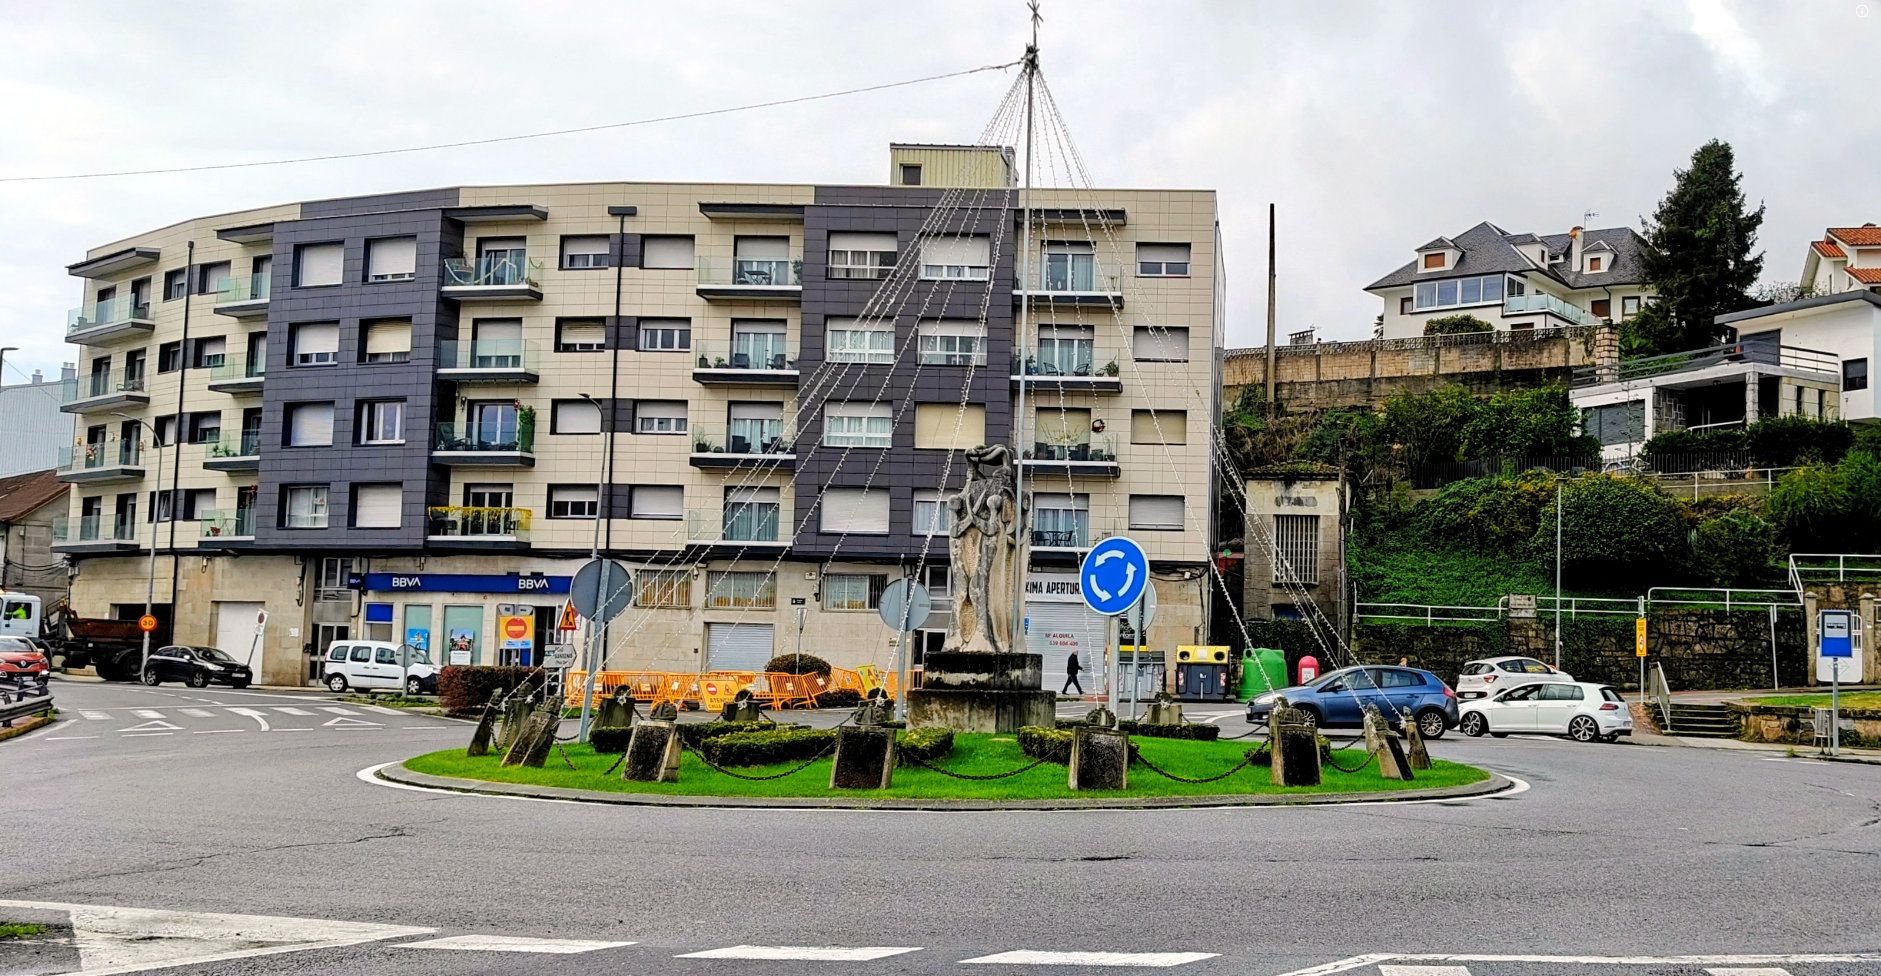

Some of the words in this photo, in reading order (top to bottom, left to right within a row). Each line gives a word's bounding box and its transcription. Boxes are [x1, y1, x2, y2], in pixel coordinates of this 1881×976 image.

[392, 576, 421, 588] BBVA
[518, 578, 549, 590] BBVA
[1025, 581, 1043, 594] XIMA
[1046, 581, 1082, 595] APERTUR
